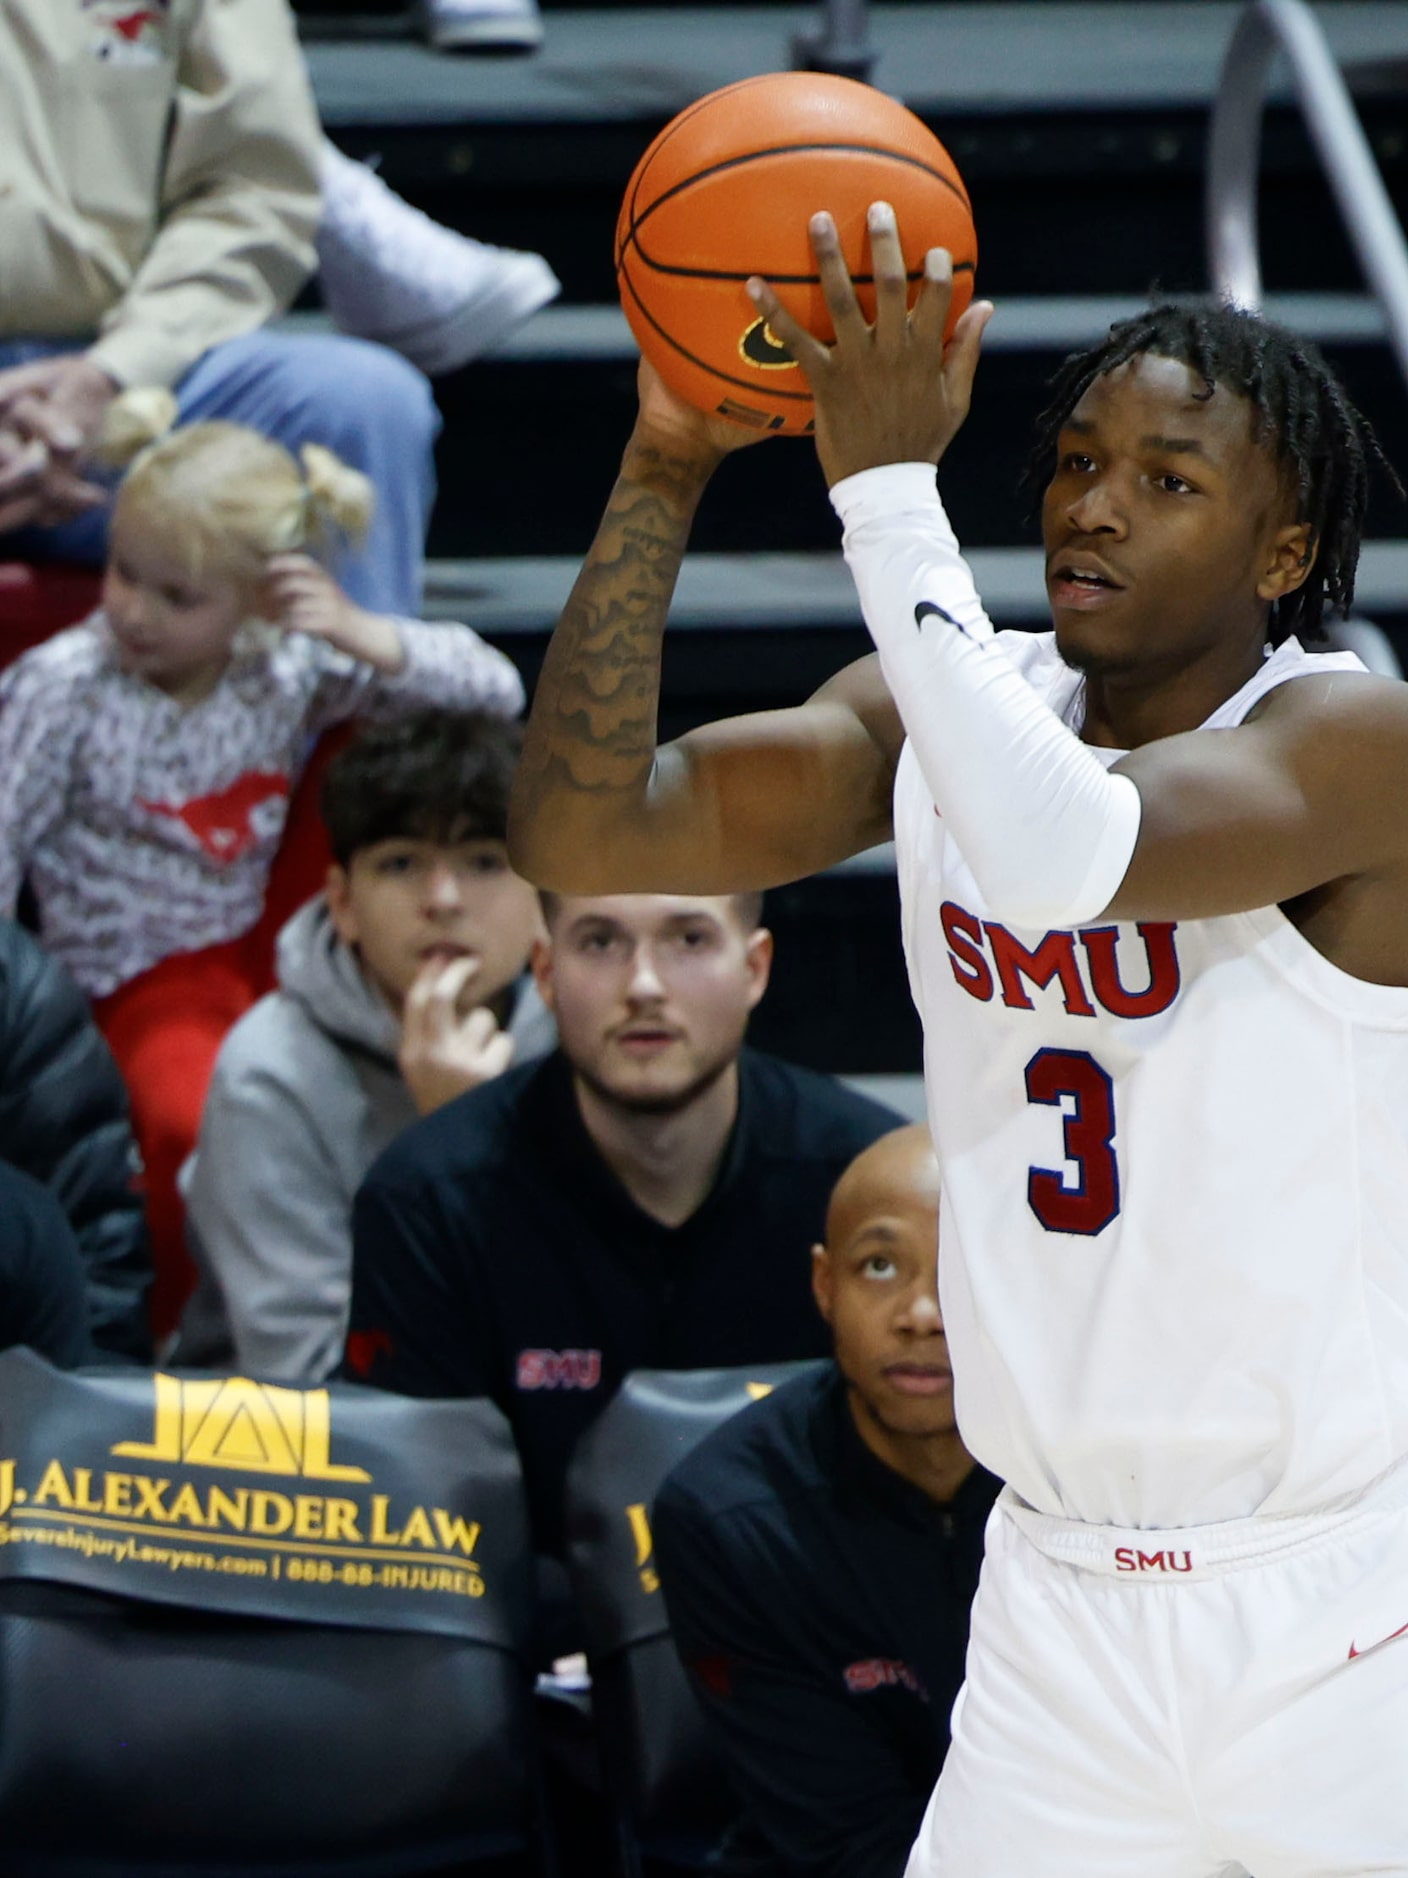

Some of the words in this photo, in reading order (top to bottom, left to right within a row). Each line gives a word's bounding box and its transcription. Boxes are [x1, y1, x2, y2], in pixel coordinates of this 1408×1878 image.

[940, 900, 1181, 1020] SMU
[1024, 1047, 1120, 1236] 3
[516, 1349, 602, 1391] SMU
[33, 1458, 363, 1544] ALEXANDER
[370, 1494, 482, 1556] LAW
[286, 1557, 486, 1599] 888-88-INJURED
[1115, 1547, 1193, 1572] SMU
